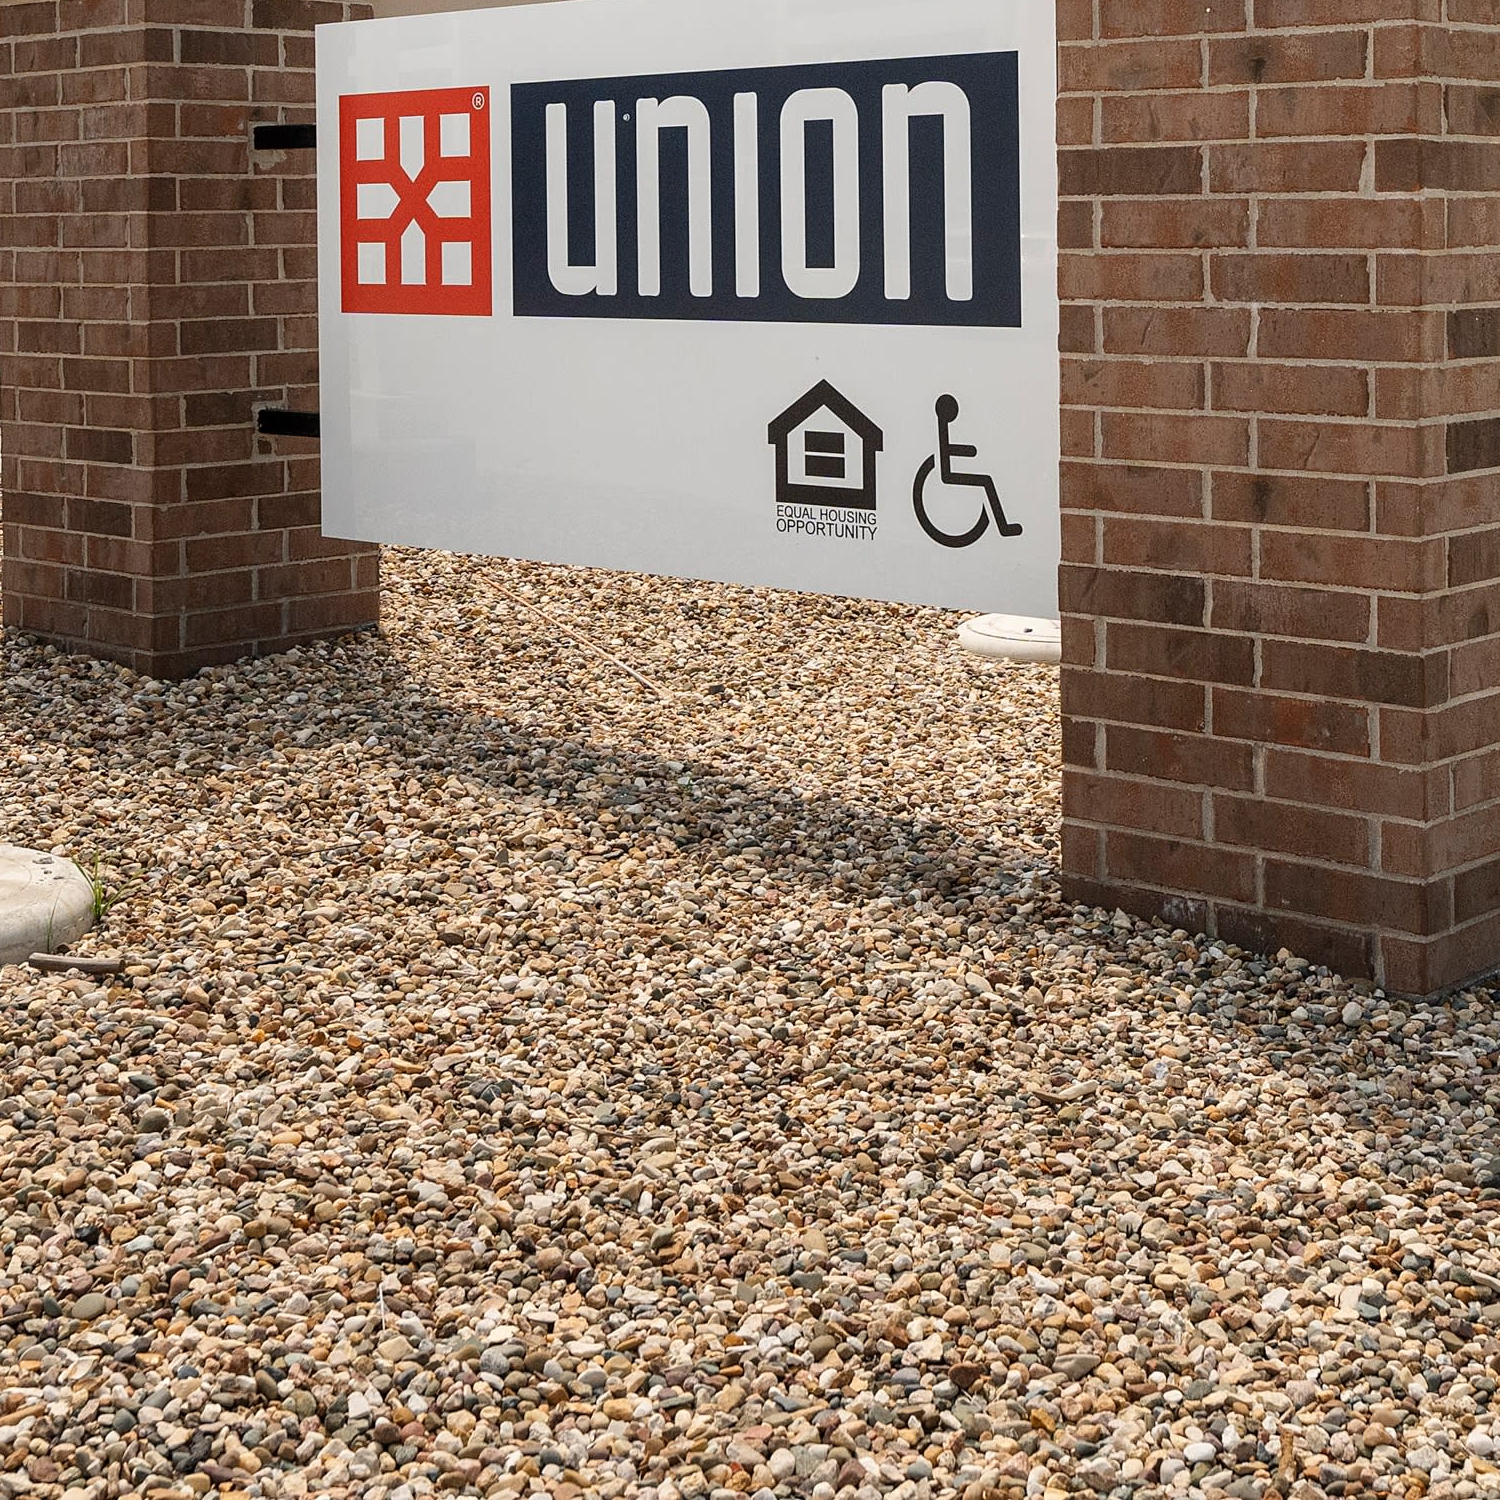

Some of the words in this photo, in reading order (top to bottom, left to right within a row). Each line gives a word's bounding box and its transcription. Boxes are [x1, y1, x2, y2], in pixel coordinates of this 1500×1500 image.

[776, 505, 817, 519] EQUAL
[820, 509, 877, 525] HOUSING
[776, 518, 878, 540] OPPORTUNITY
